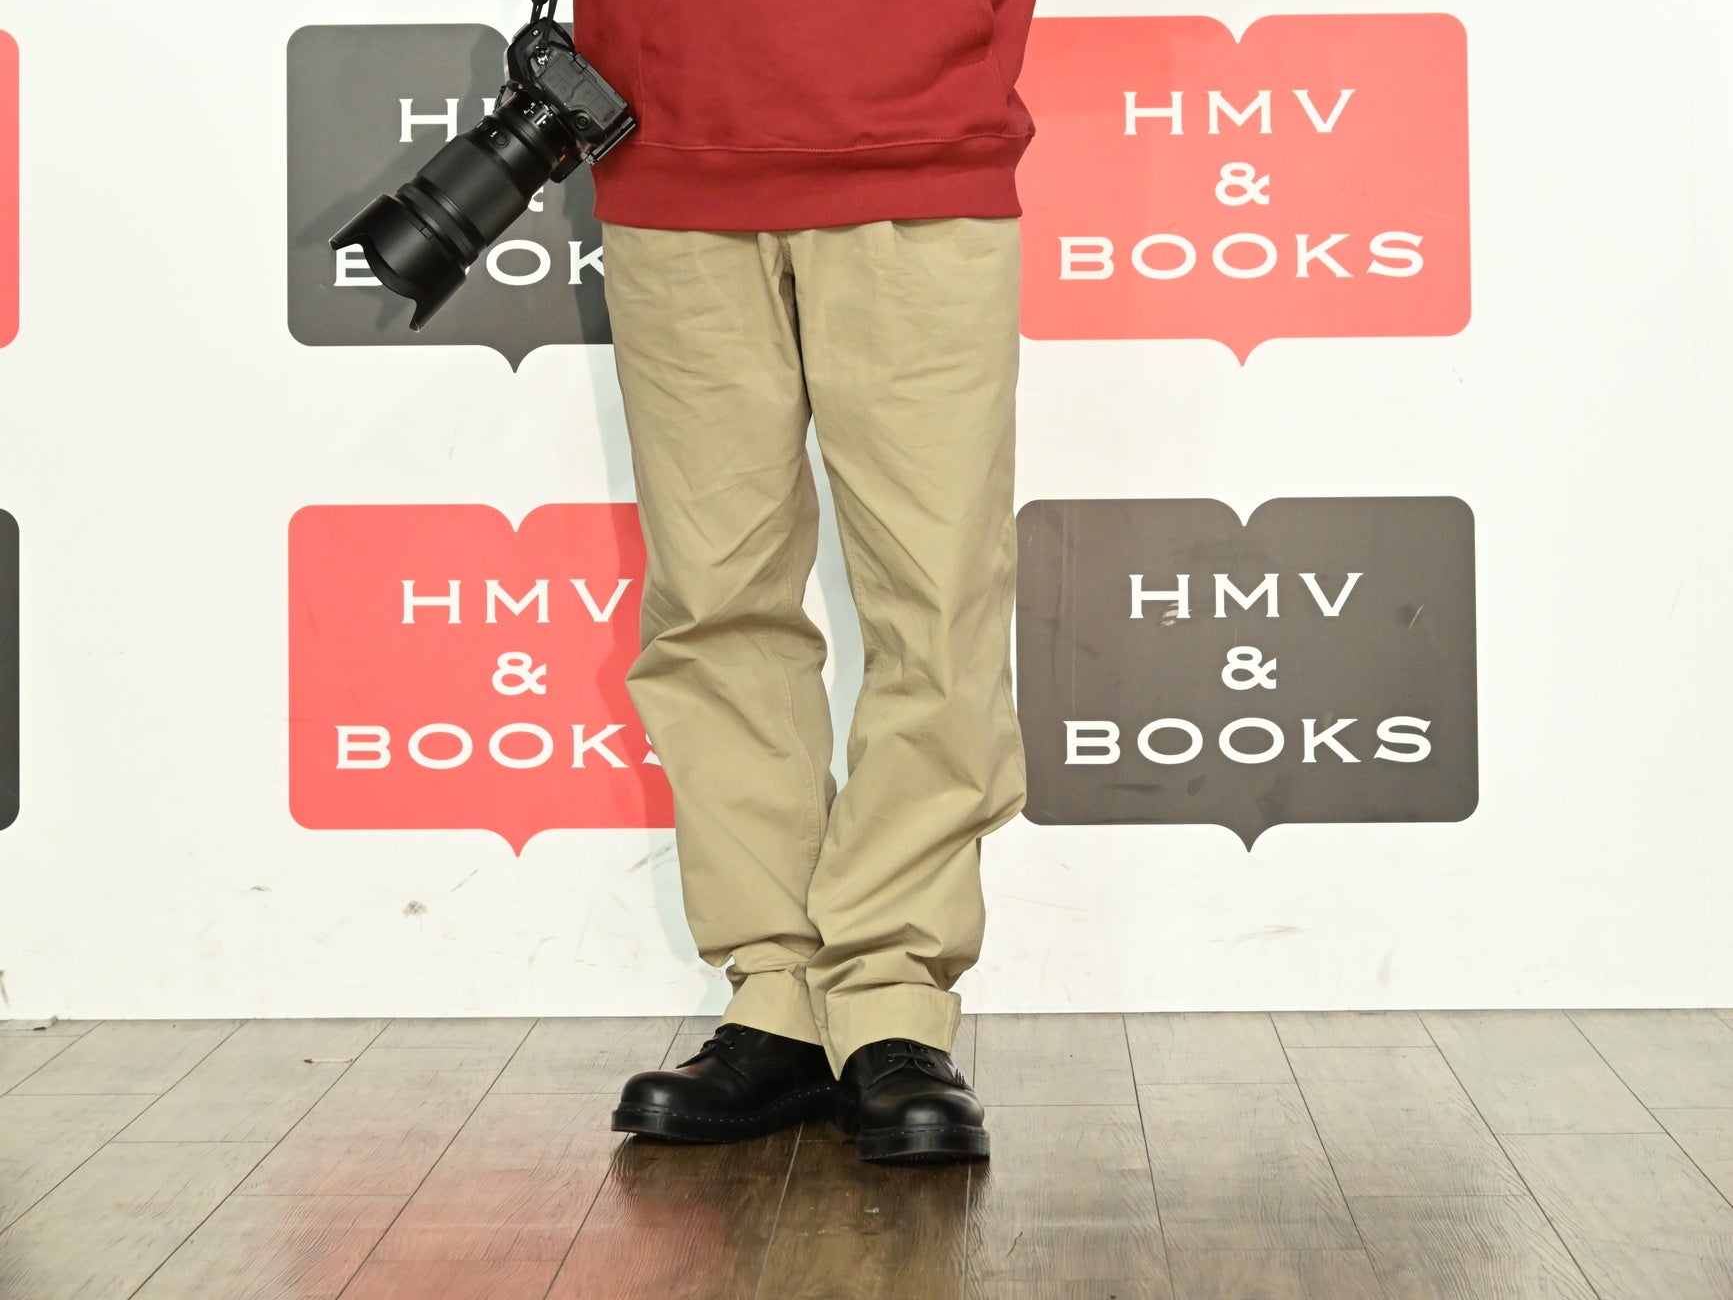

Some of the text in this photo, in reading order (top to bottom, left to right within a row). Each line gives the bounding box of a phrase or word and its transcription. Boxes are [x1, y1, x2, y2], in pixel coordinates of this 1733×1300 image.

[1123, 88, 1356, 135] HMV
[1215, 162, 1270, 206] &
[1058, 231, 1424, 280] BOOKS
[401, 578, 634, 624] HMV
[1129, 572, 1364, 619] HMV
[492, 651, 546, 695] &
[1221, 645, 1277, 690] &
[1063, 716, 1431, 765] BOOKS
